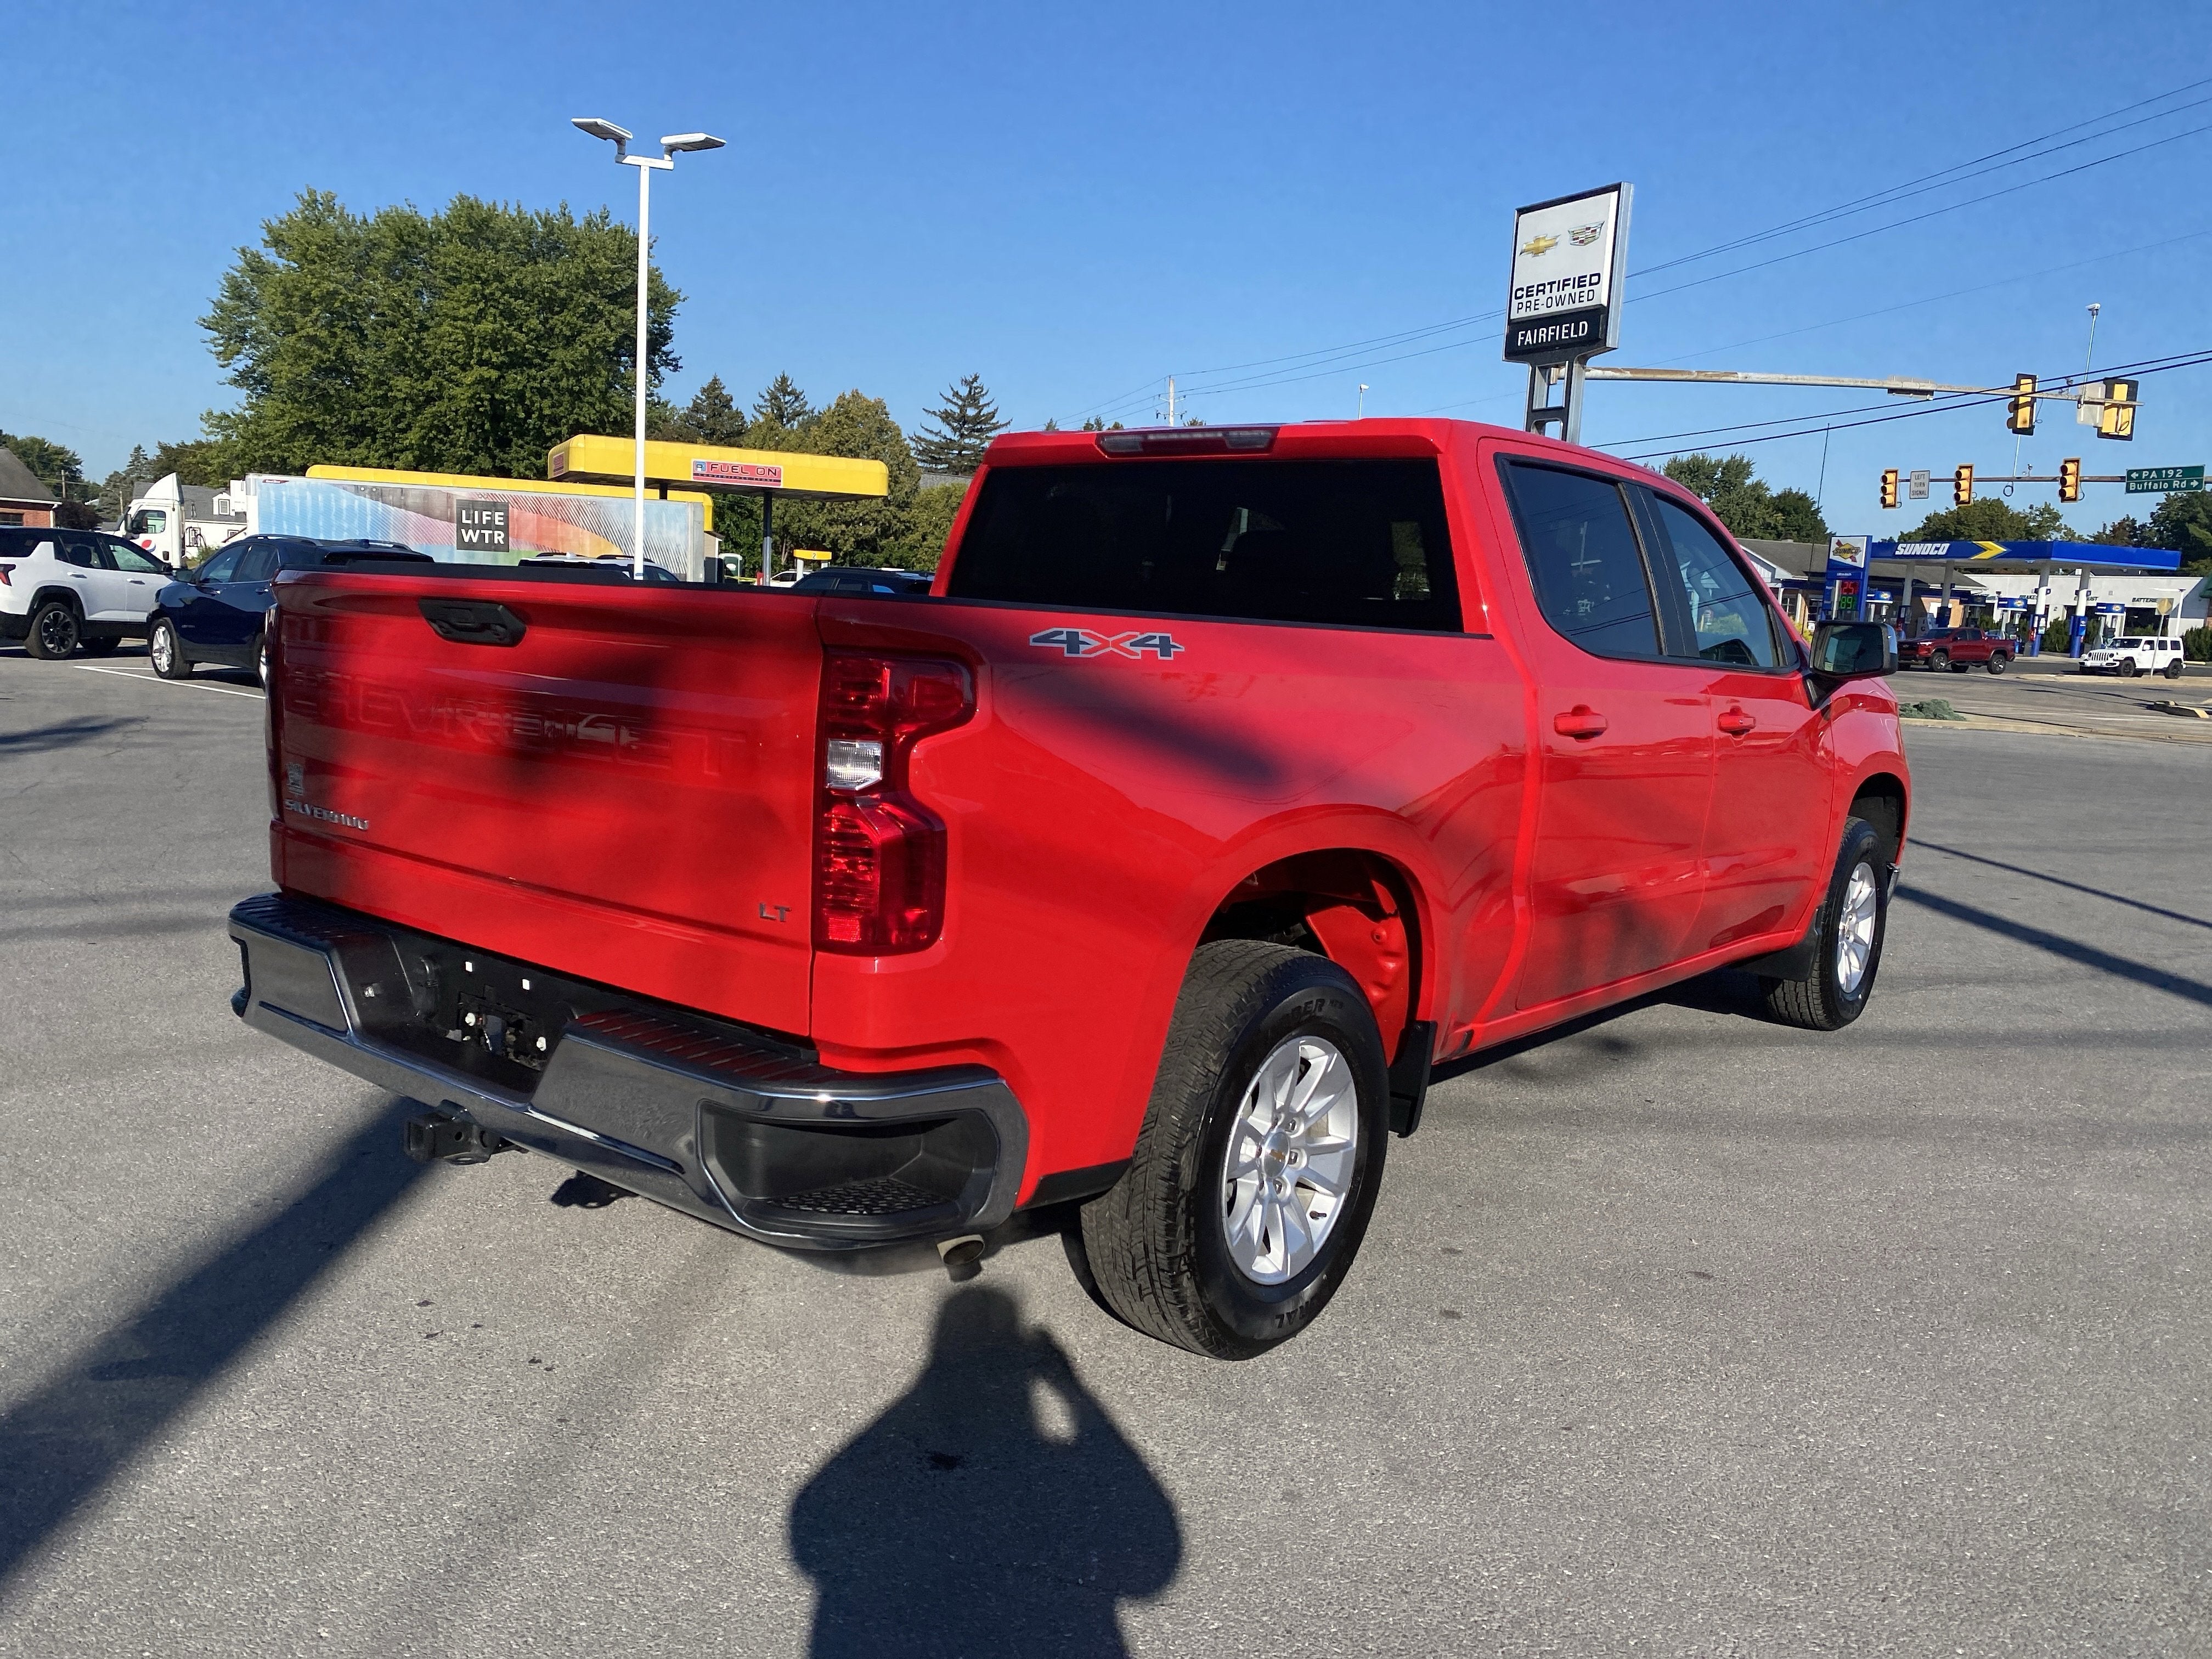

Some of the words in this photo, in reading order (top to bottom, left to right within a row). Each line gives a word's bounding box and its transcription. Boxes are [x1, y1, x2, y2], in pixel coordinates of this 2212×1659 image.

[1514, 272, 1601, 300] CERTIFIED
[1517, 289, 1595, 314] PRE-OWNED
[1517, 321, 1588, 346] FAIRFIELD
[710, 464, 749, 475] FUEL
[757, 467, 777, 476] ON
[2142, 470, 2158, 479] PA
[2162, 469, 2183, 478] 192
[2129, 481, 2169, 490] Buffalo
[2173, 479, 2187, 488] Rd
[461, 510, 504, 526] LIFE
[461, 528, 505, 544] WTR
[1895, 543, 1950, 555] SUNOCO
[759, 903, 792, 922] LT
